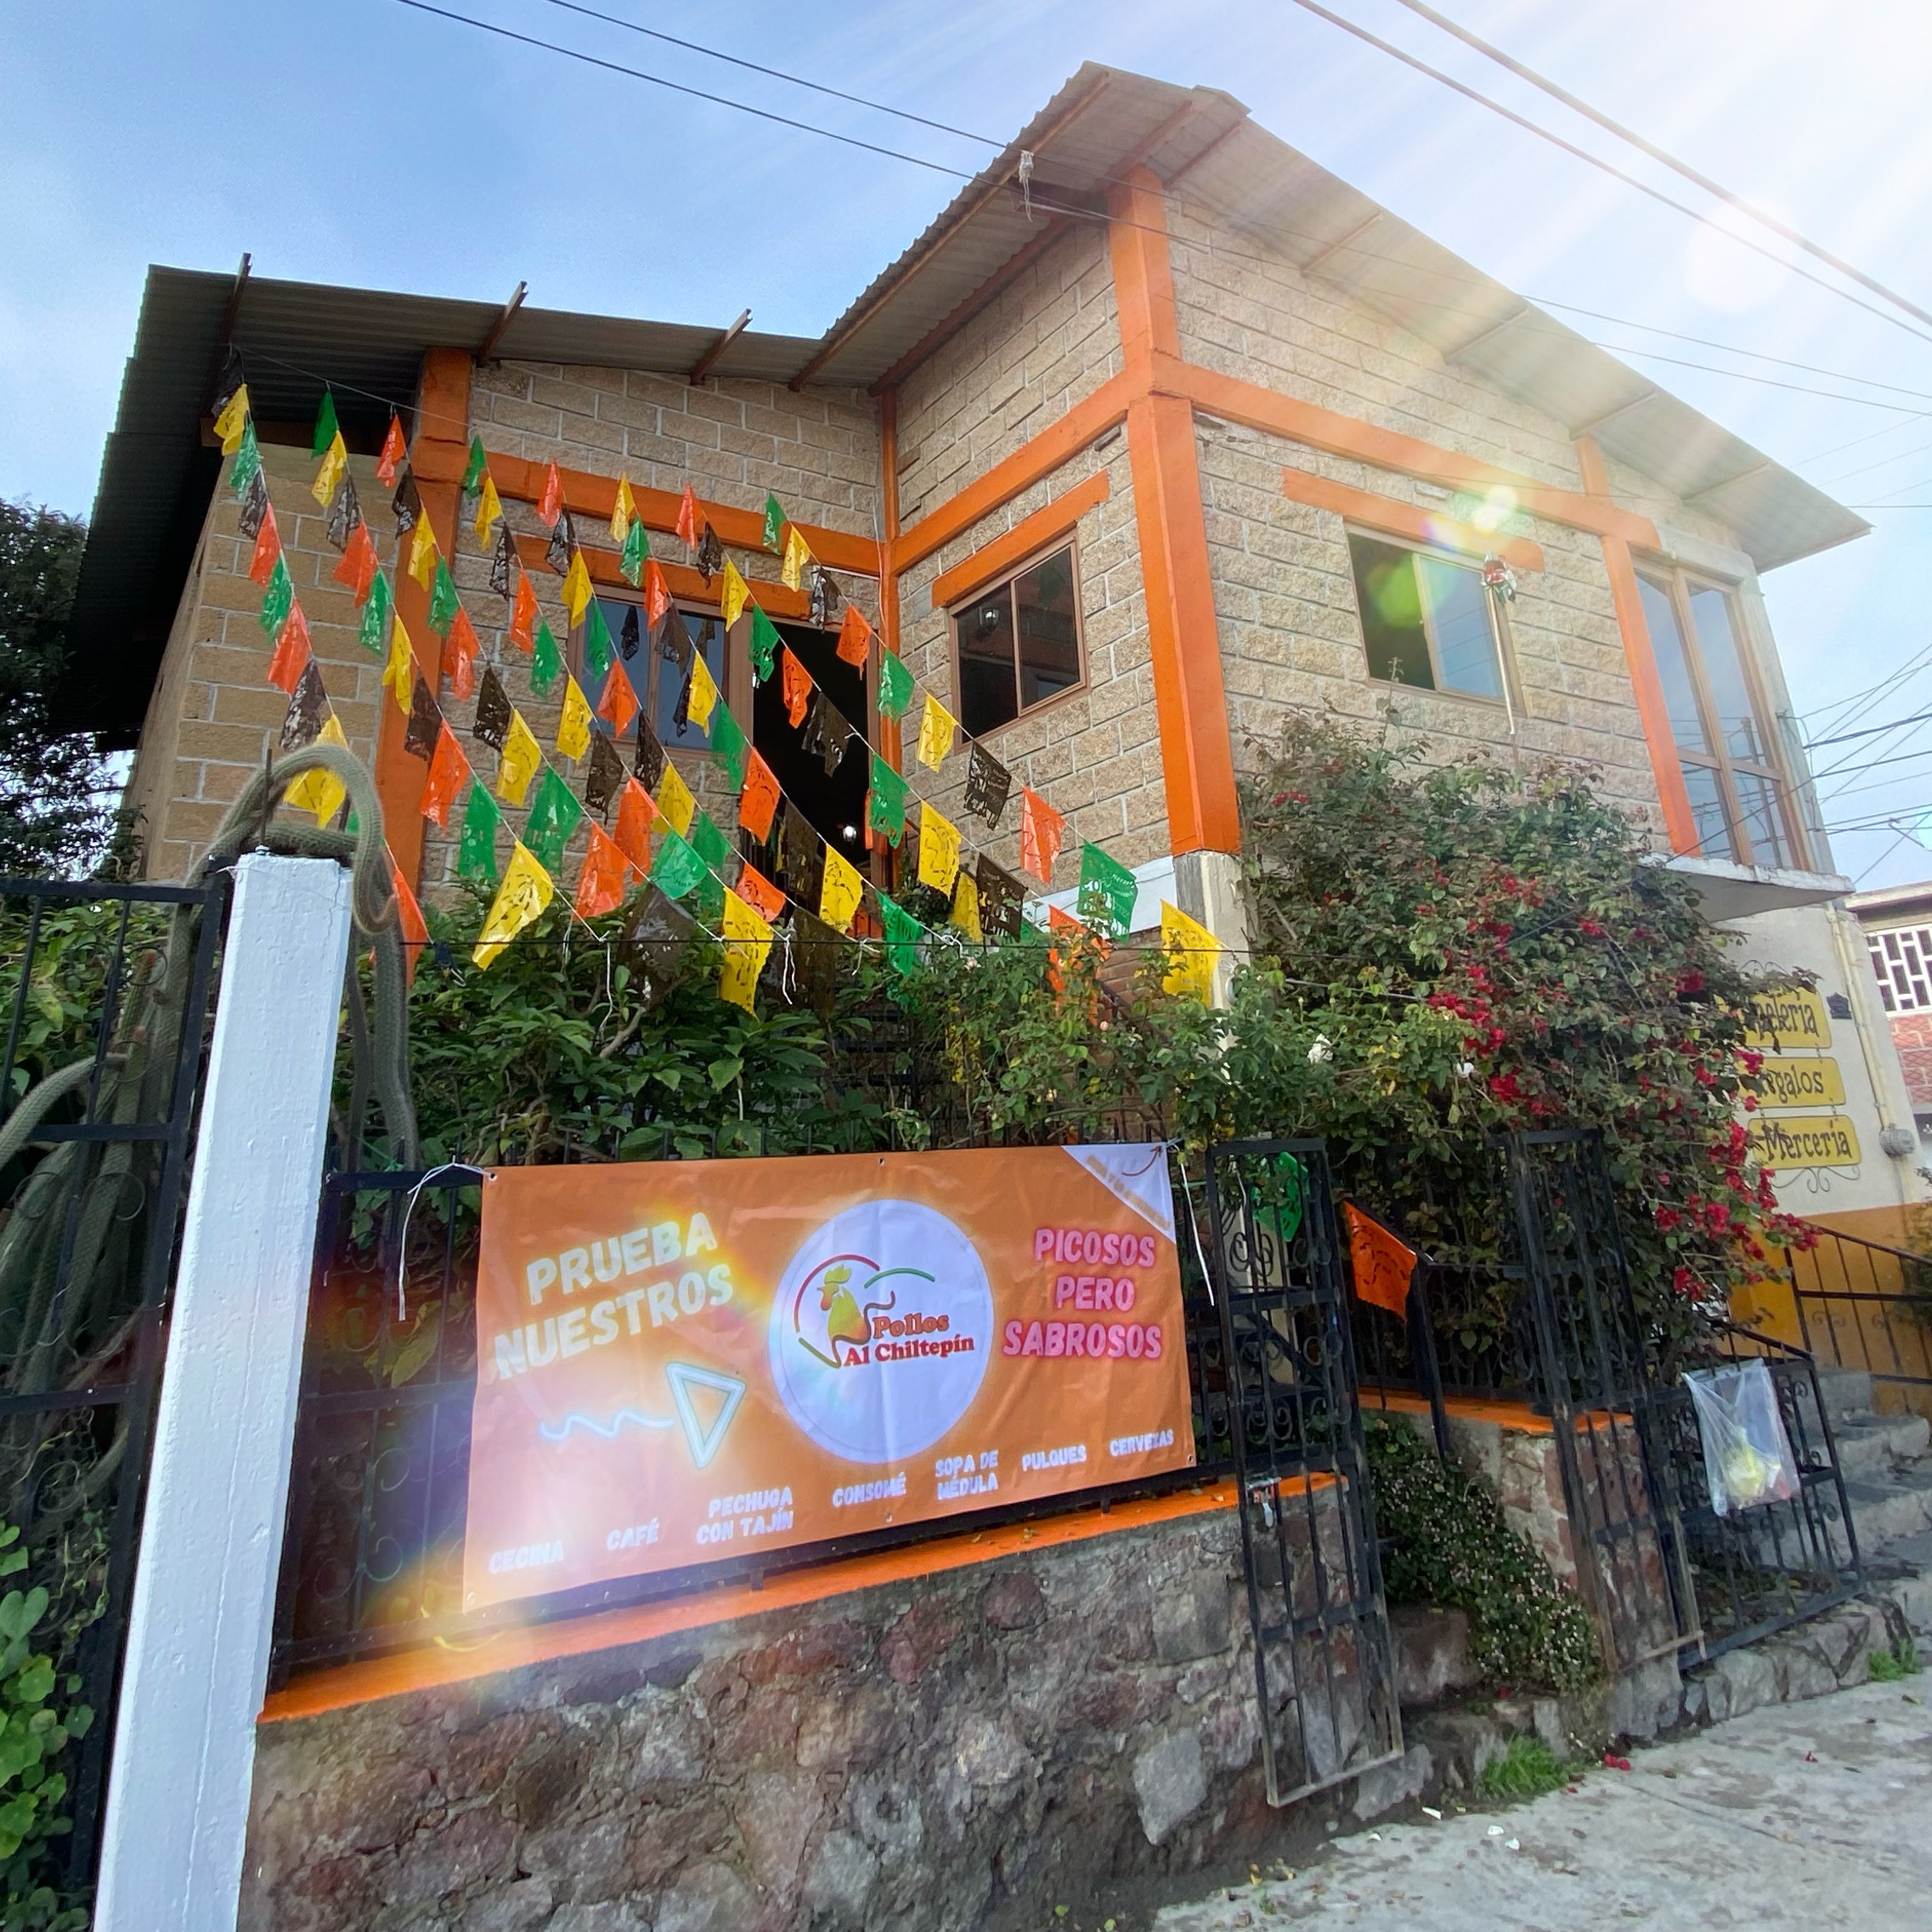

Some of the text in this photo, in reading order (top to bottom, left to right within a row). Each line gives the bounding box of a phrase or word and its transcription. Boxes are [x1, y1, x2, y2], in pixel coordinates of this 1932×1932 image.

[1760, 1065, 1824, 1104] egalos
[1760, 1120, 1852, 1161] Mercería
[526, 1212, 718, 1305] PRUEBA
[1033, 1228, 1155, 1268] PICOSOS
[1055, 1276, 1135, 1312] PERO
[494, 1264, 733, 1380] NUESTROS
[873, 1313, 950, 1339] Pollos
[844, 1334, 975, 1367] Al Chiltepín
[1003, 1320, 1162, 1359] SABROSOS
[1022, 1445, 1087, 1472] PULQUES
[1110, 1428, 1175, 1456] CERVEZAS
[935, 1449, 999, 1478] SOPA DE
[709, 1486, 794, 1519] PECHUGA
[832, 1472, 907, 1507] CONSOMÉ
[937, 1472, 999, 1500] MÉDULA
[607, 1517, 659, 1551] CAFÉ
[696, 1506, 794, 1545] CON TAJÍN
[489, 1541, 564, 1574] CECINA
